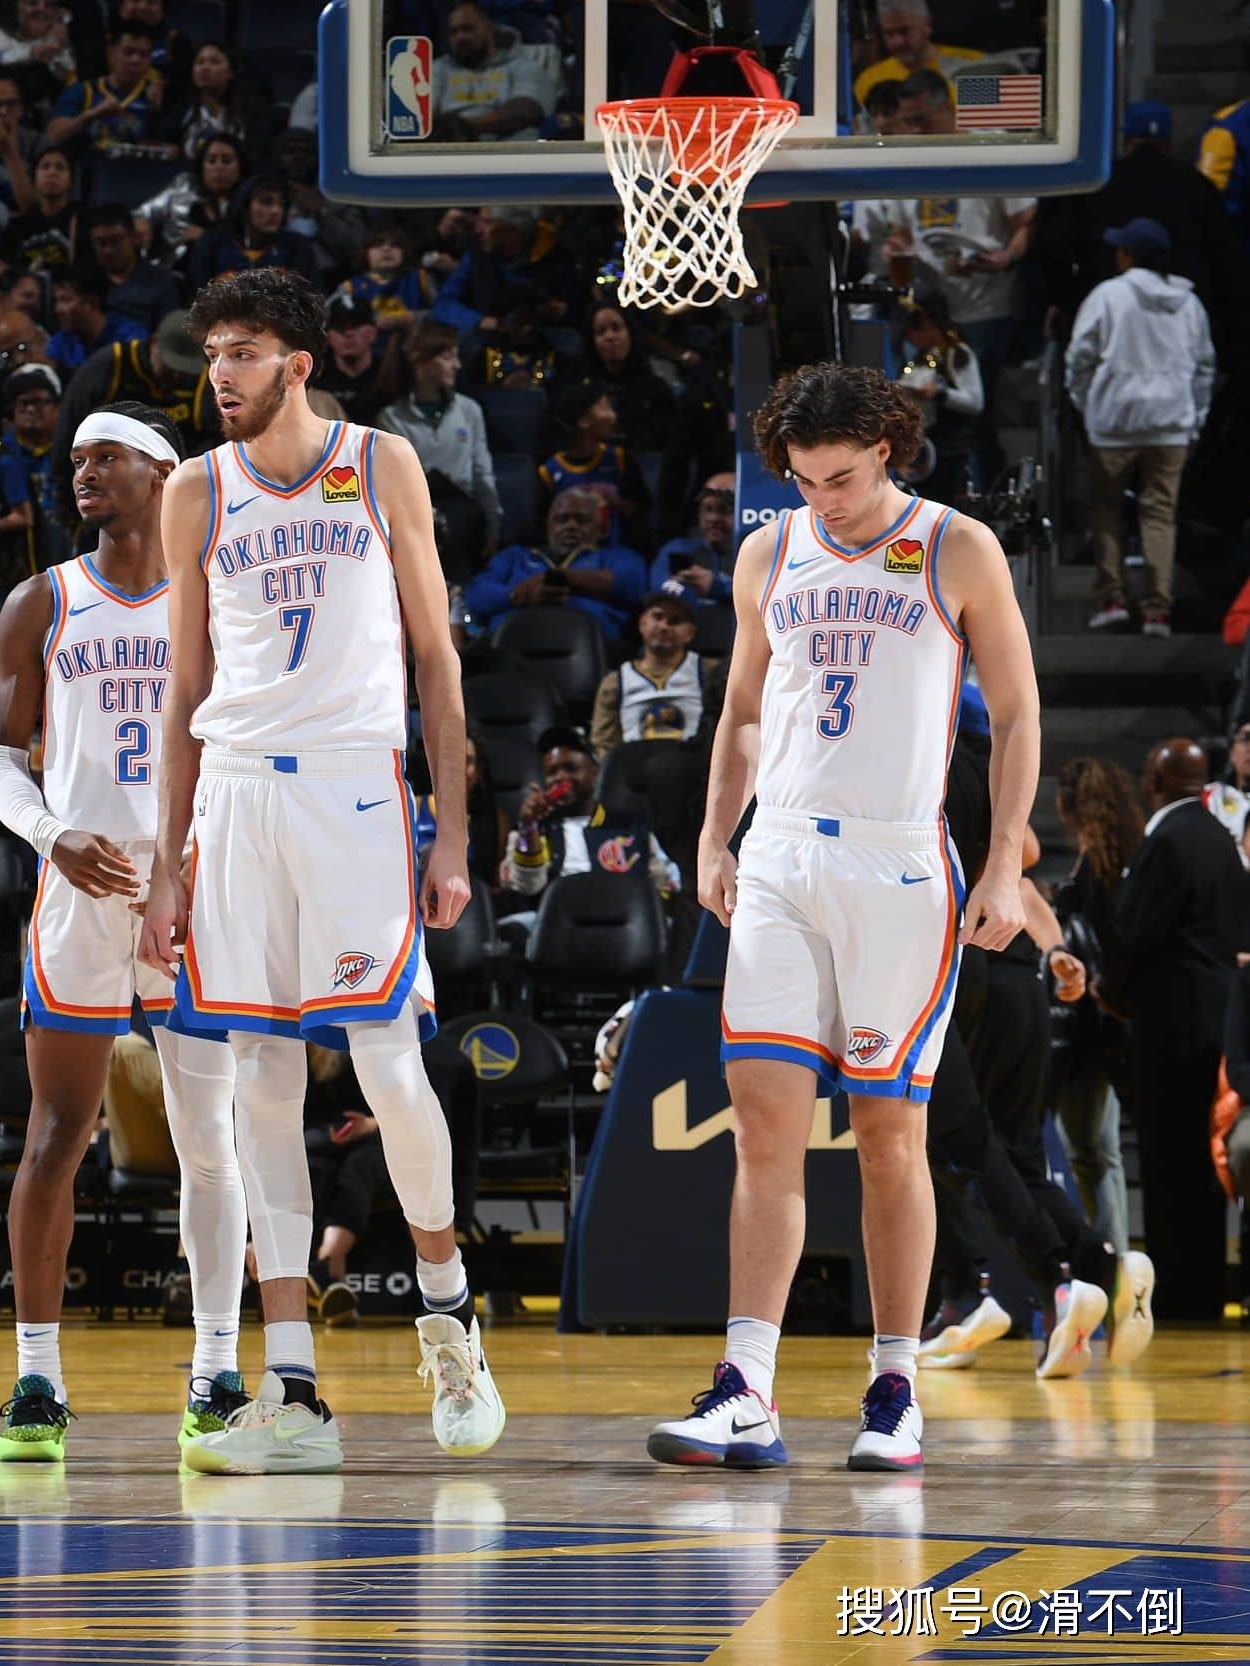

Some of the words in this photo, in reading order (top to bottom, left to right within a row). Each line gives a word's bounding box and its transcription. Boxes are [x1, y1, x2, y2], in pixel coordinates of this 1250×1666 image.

[214, 519, 373, 577] OKLAHOMA
[261, 561, 327, 604] CITY
[770, 586, 928, 636] OKLAHOMA
[54, 636, 172, 683] OKLAHO
[279, 603, 315, 676] 7
[809, 630, 876, 666] CITY
[100, 678, 166, 713] CITY
[816, 670, 858, 741] 3
[115, 718, 151, 785] 2
